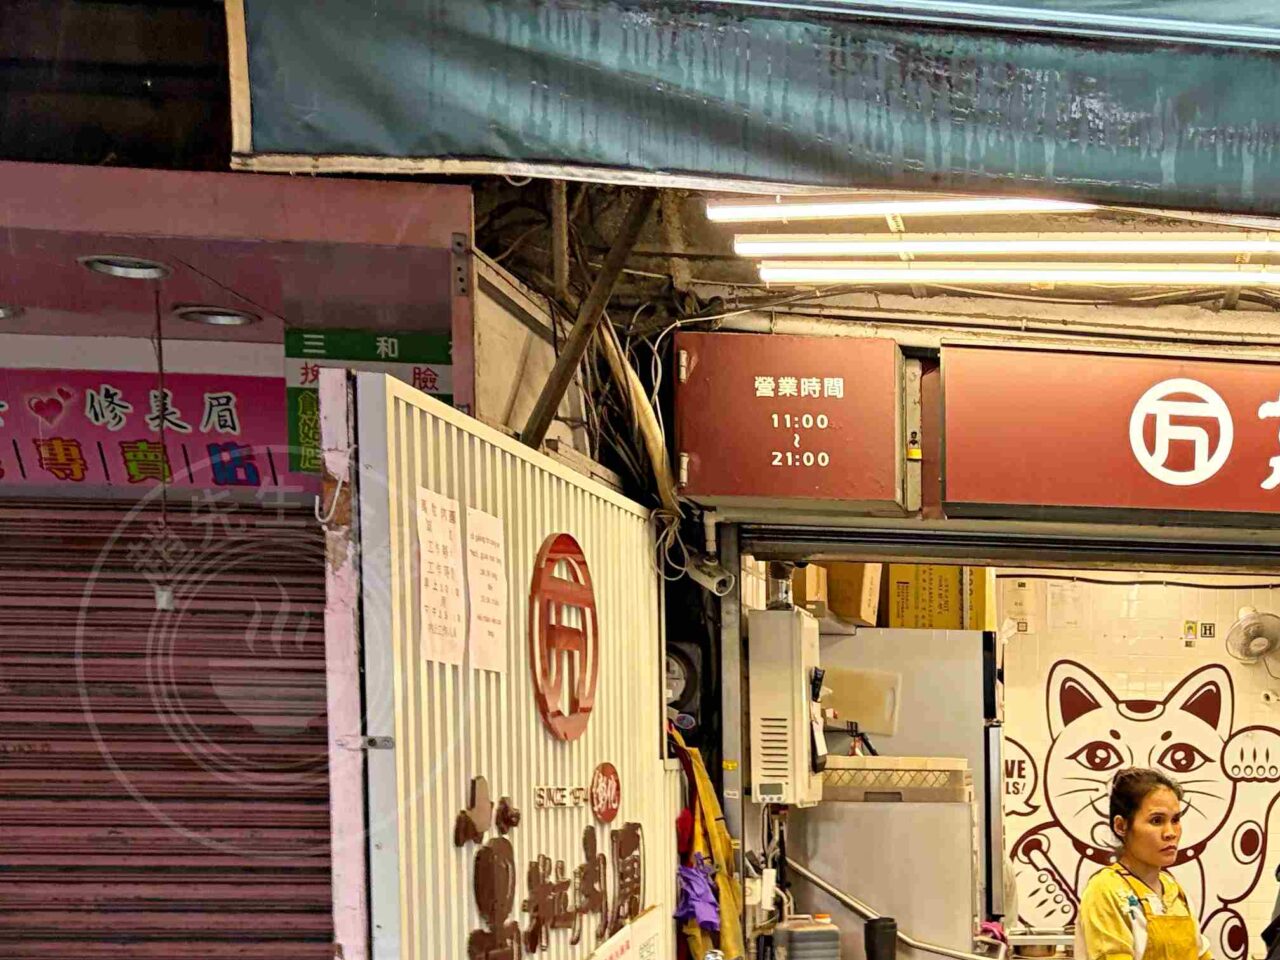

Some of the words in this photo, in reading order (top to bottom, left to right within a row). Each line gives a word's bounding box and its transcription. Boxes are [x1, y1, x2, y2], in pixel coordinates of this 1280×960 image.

[754, 376, 844, 398] 營業時間
[771, 413, 829, 429] 11:00
[771, 451, 830, 467] 21:00
